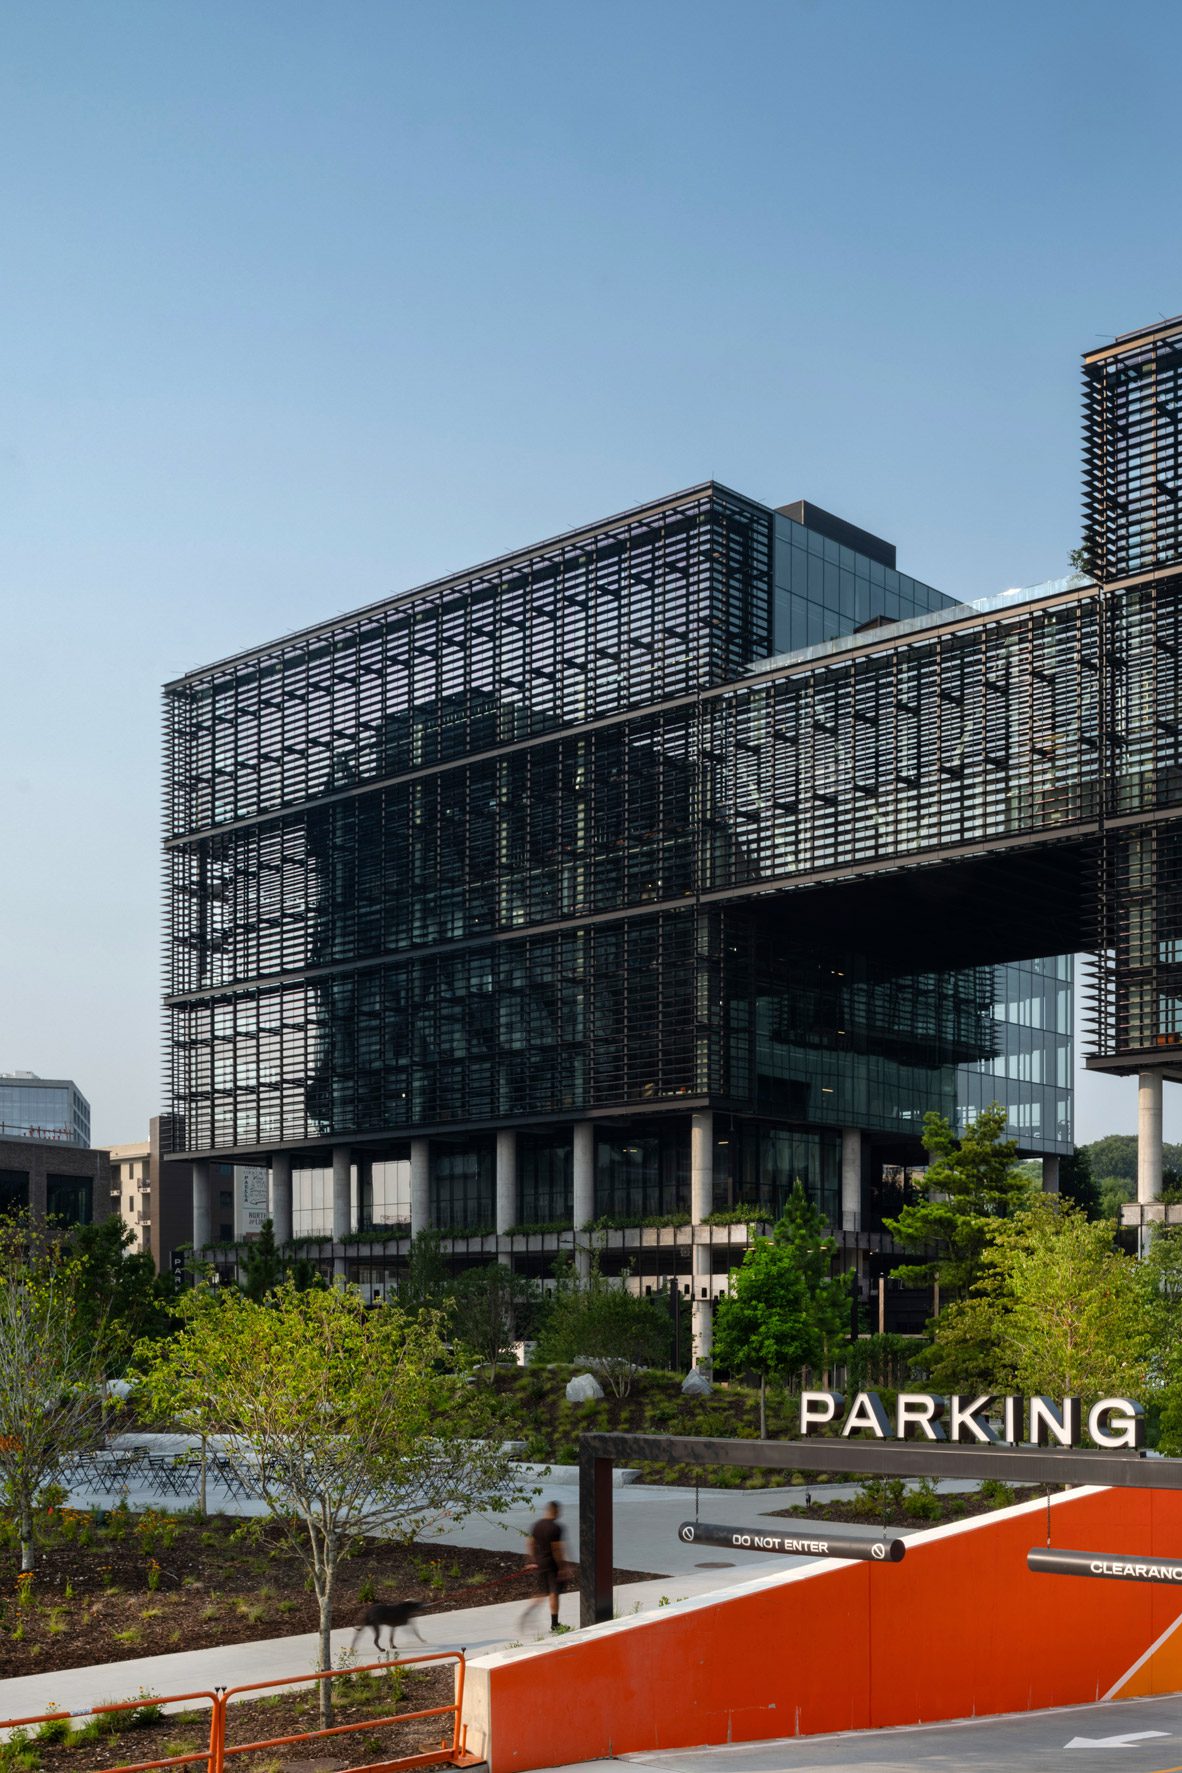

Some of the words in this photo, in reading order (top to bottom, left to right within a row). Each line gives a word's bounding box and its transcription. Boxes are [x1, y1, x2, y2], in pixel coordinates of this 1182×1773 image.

[801, 1391, 1142, 1448] PARKING
[732, 1534, 751, 1546] DO
[754, 1536, 781, 1549] NOT
[784, 1538, 829, 1553] ENTER
